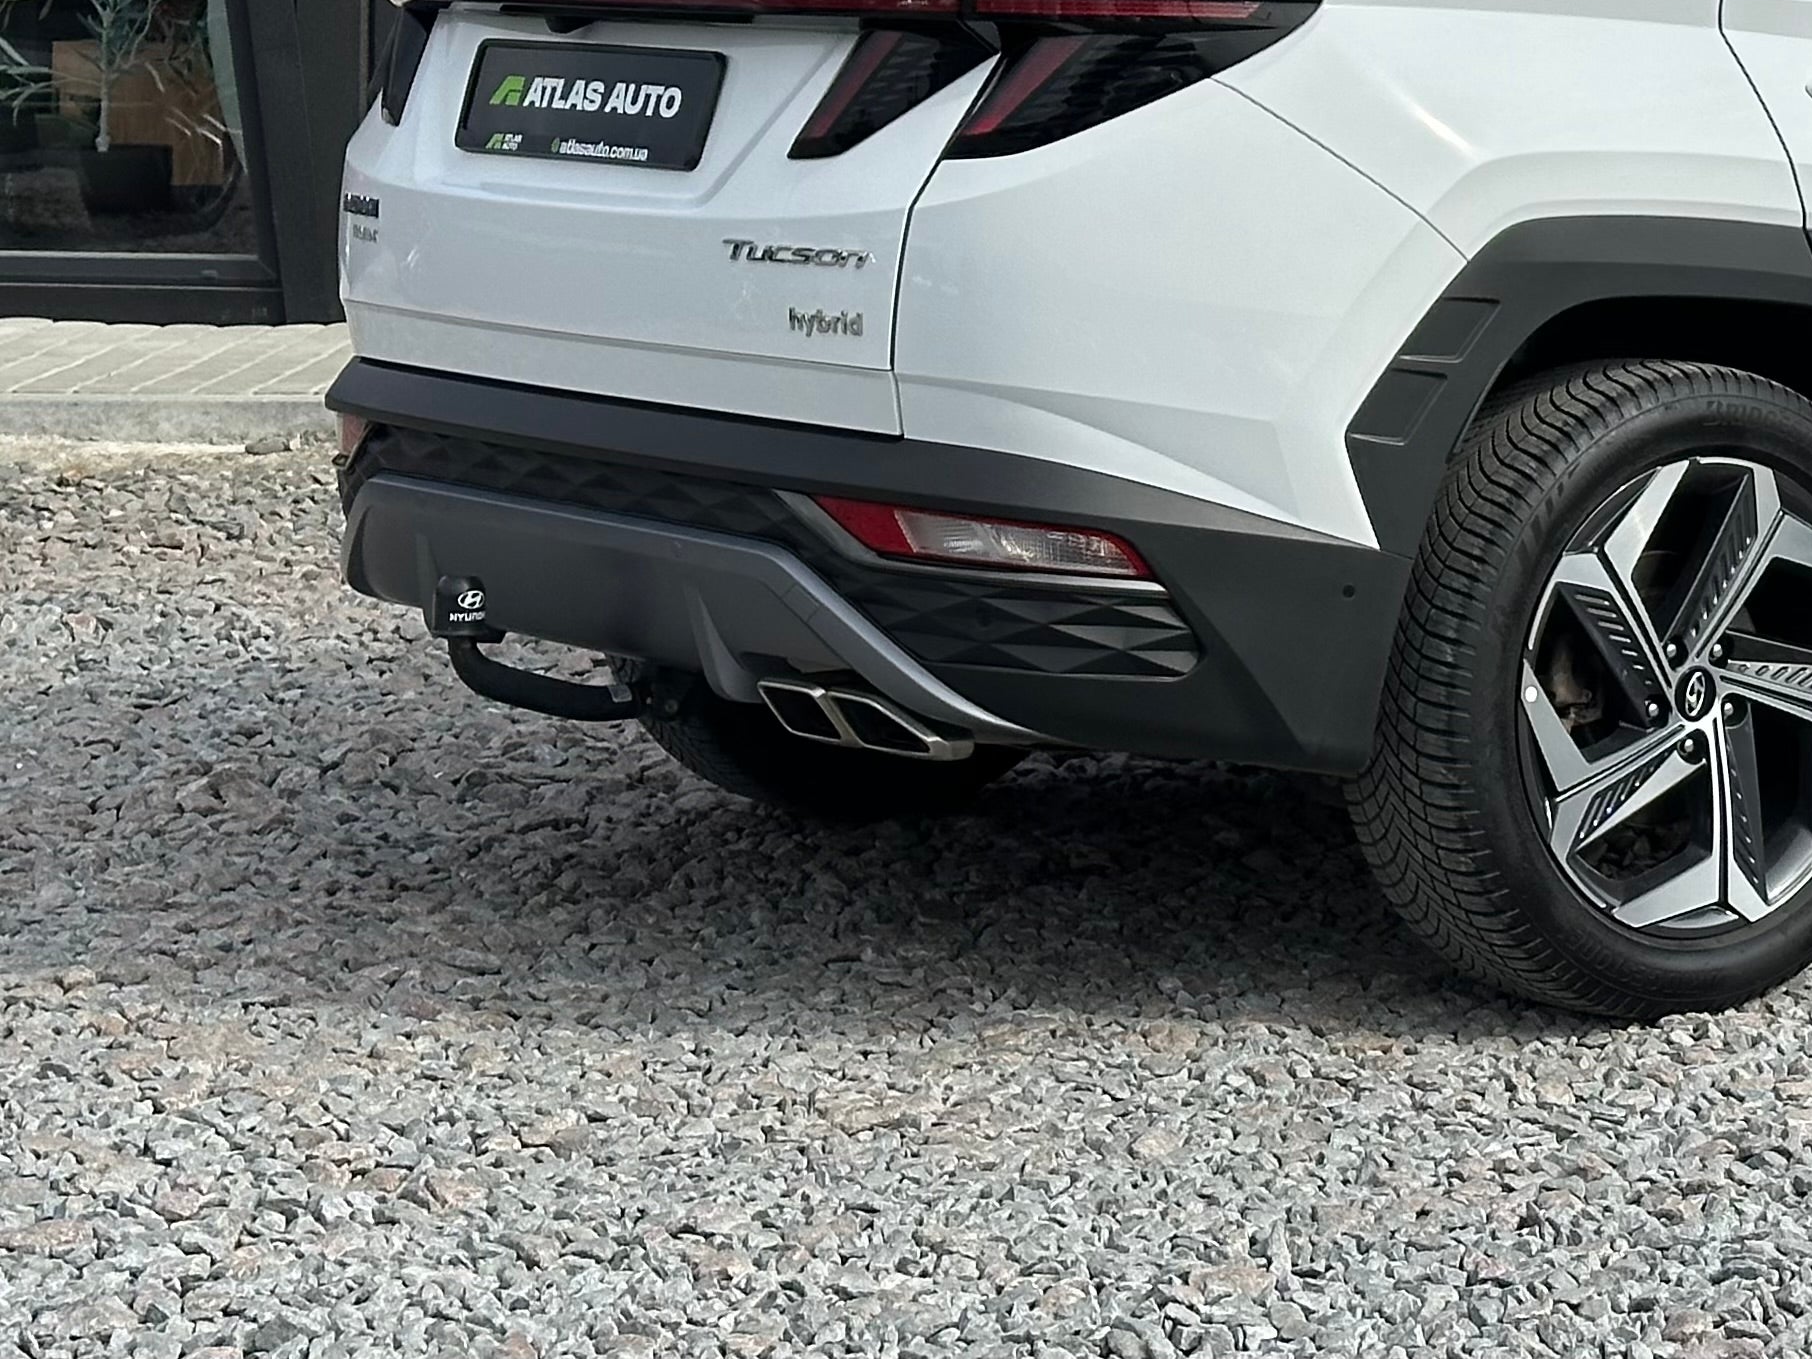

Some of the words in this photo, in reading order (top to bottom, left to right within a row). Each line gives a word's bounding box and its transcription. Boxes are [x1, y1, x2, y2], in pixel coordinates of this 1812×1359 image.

[523, 76, 605, 112] ATLAS
[604, 82, 682, 118] AUTO
[788, 307, 863, 337] hybrid
